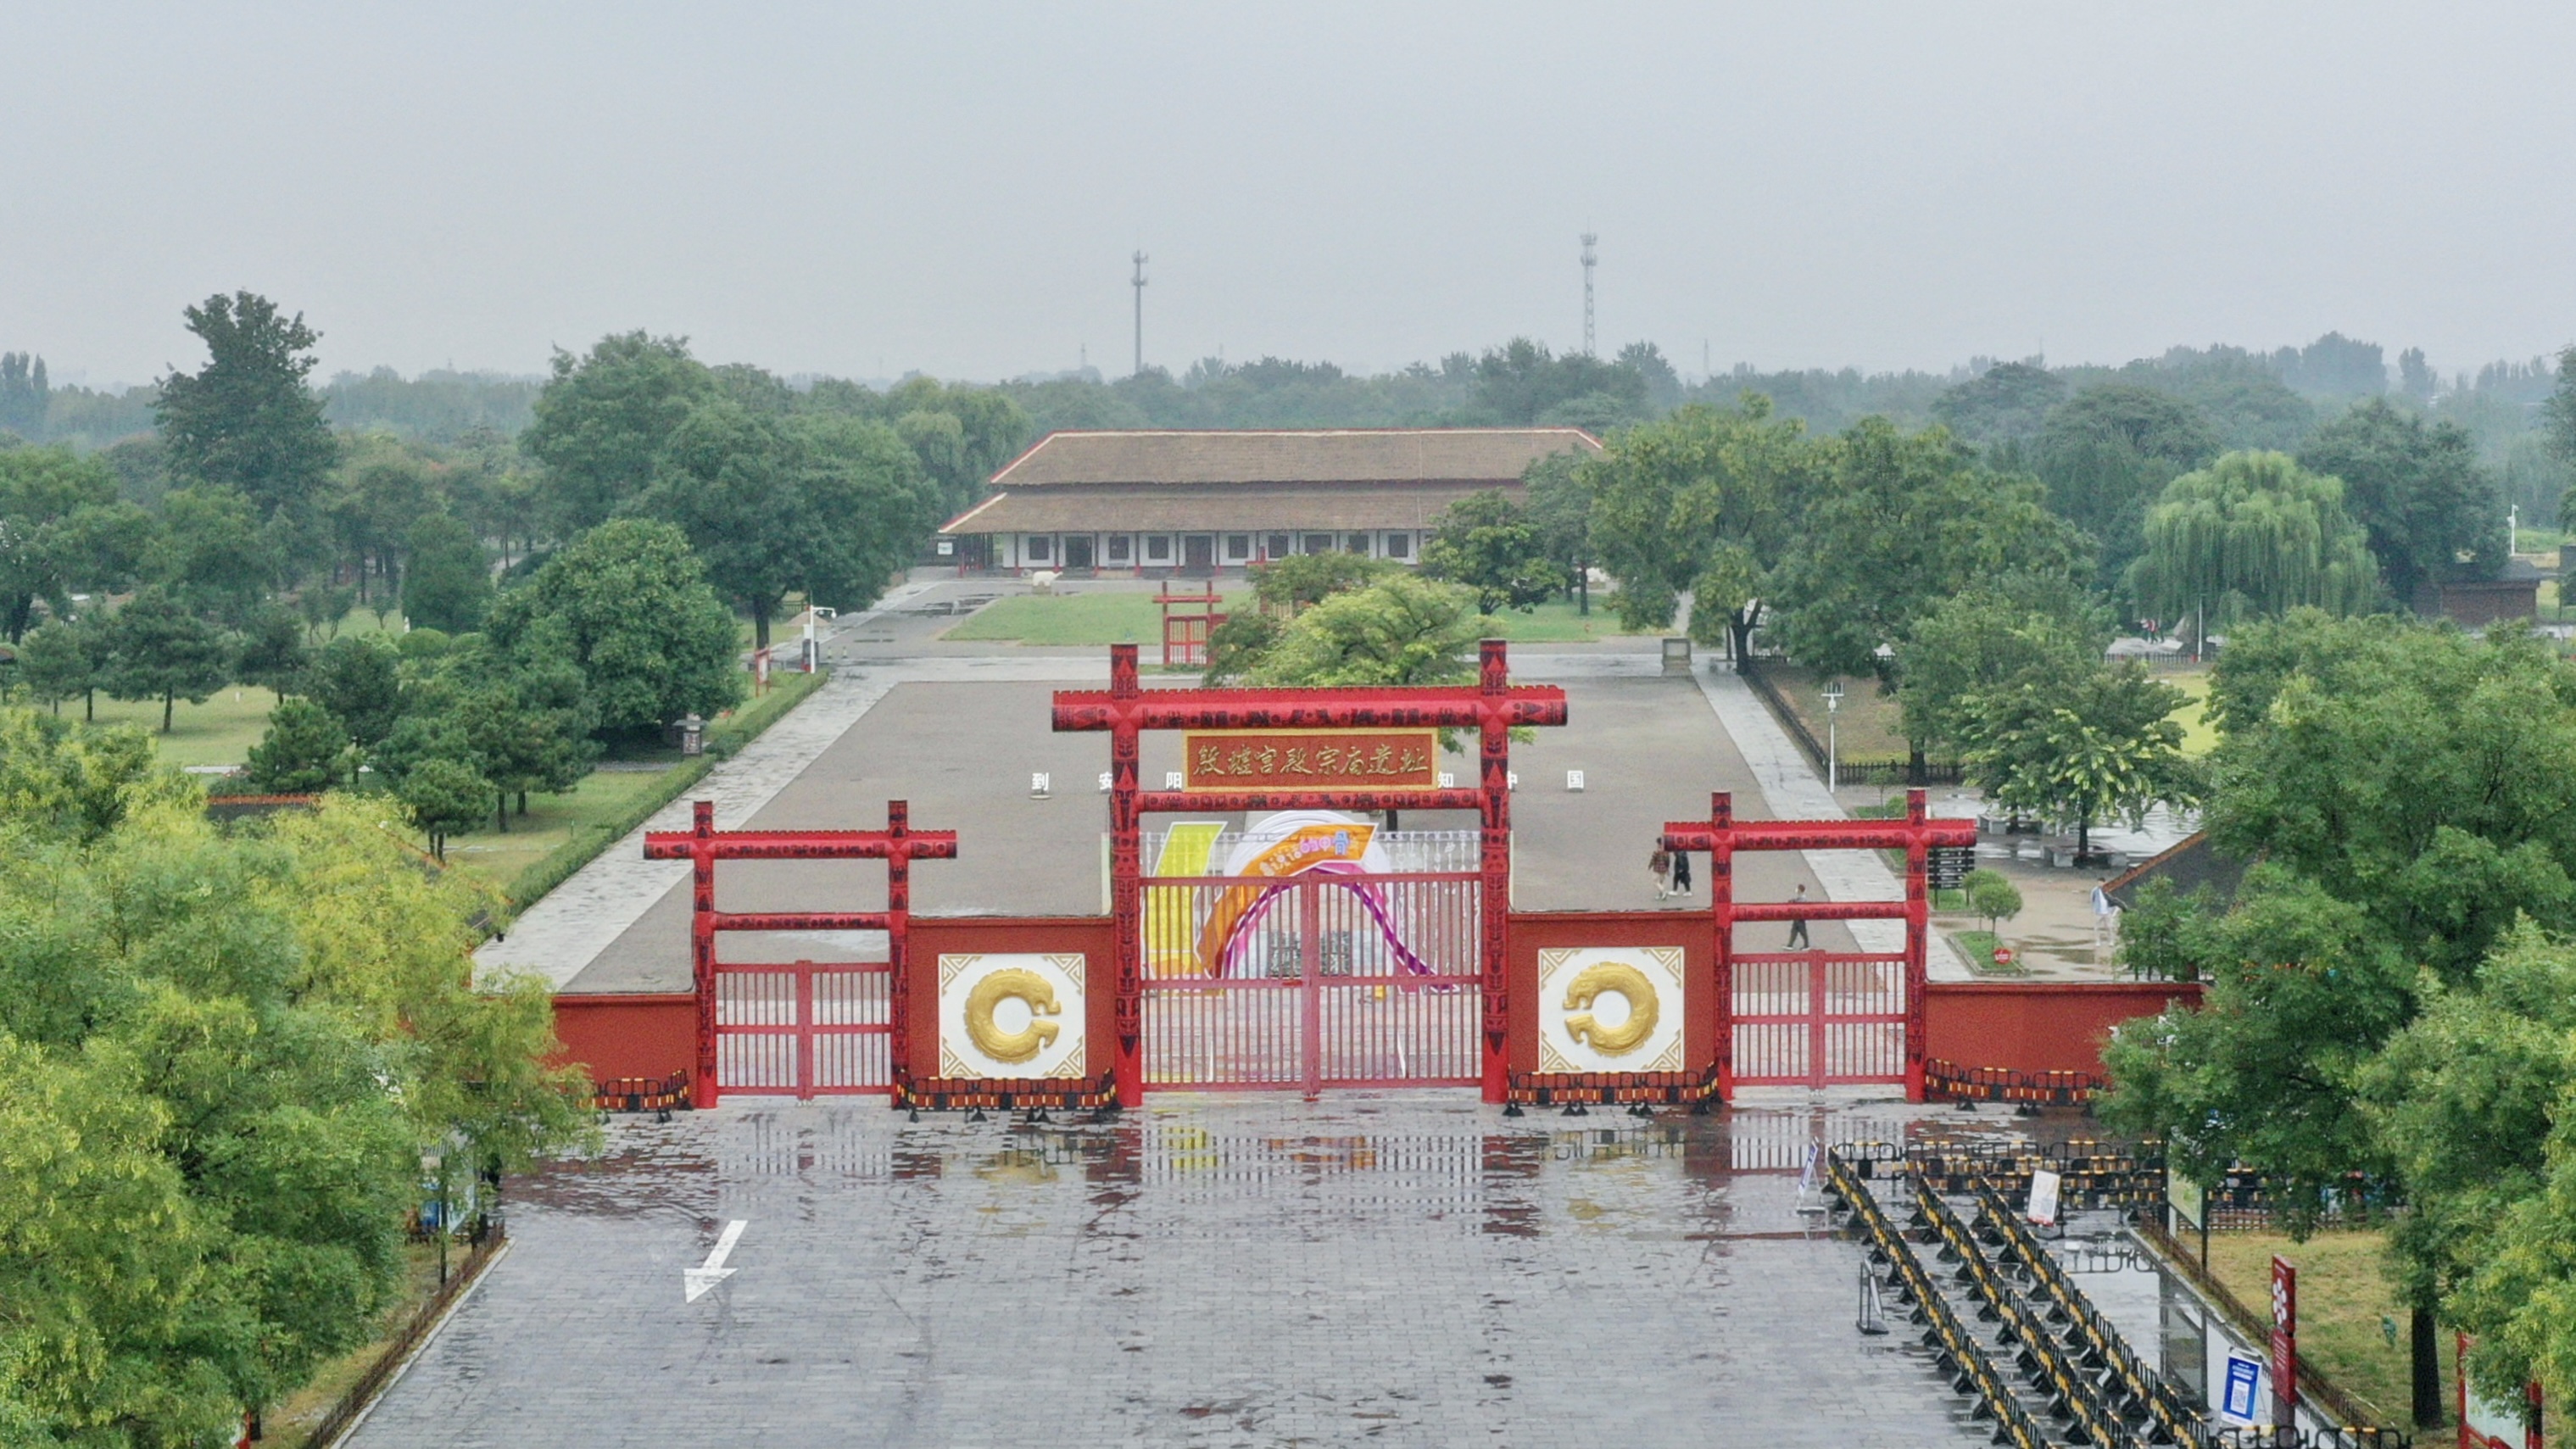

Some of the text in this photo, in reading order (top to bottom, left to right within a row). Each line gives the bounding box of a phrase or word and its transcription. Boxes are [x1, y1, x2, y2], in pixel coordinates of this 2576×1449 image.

[1193, 743, 1429, 776] 殷墟宫殿宗庙遗址
